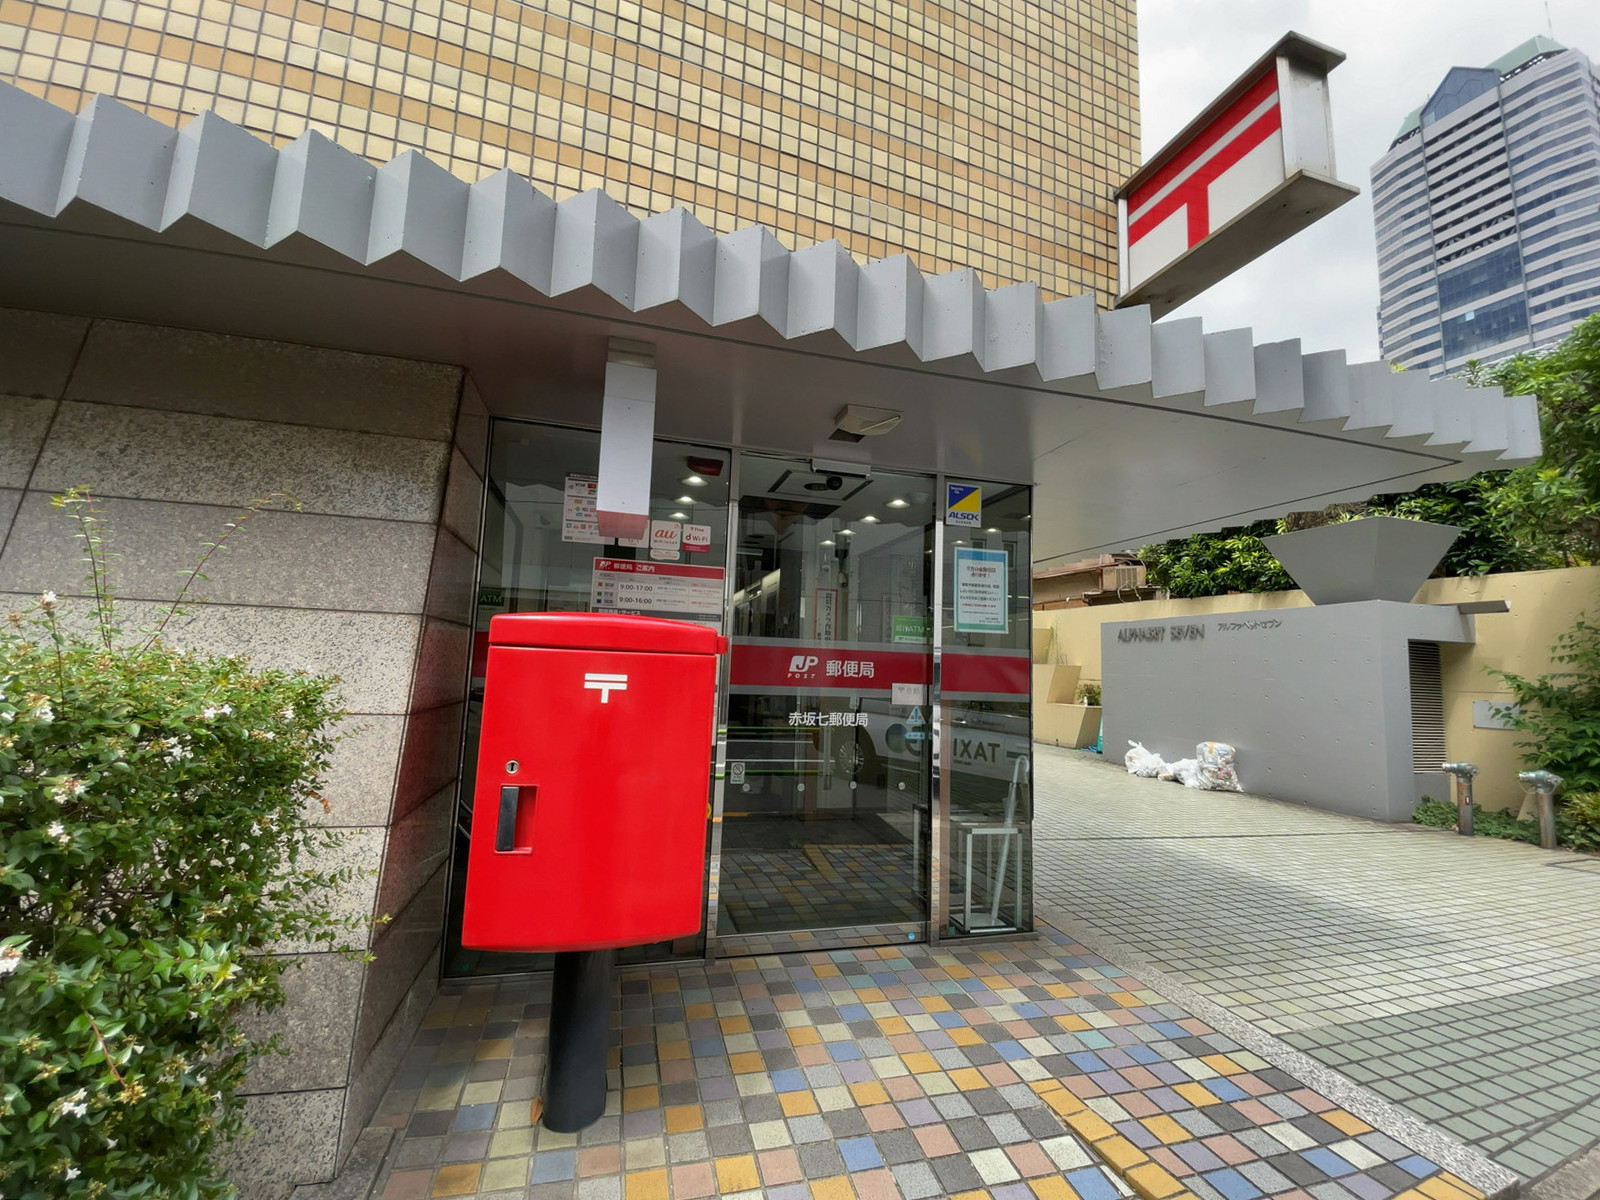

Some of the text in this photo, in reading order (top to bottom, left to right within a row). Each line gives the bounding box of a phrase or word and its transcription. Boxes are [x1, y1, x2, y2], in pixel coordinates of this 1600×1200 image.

[948, 511, 979, 521] ALSOK
[655, 529, 677, 539] au
[692, 535, 708, 543] Wi-Fi
[636, 565, 655, 573] ご案内
[1170, 623, 1206, 641] SEVEN
[825, 659, 875, 679] 郵便局
[788, 711, 869, 728] 赤坂七郵便局
